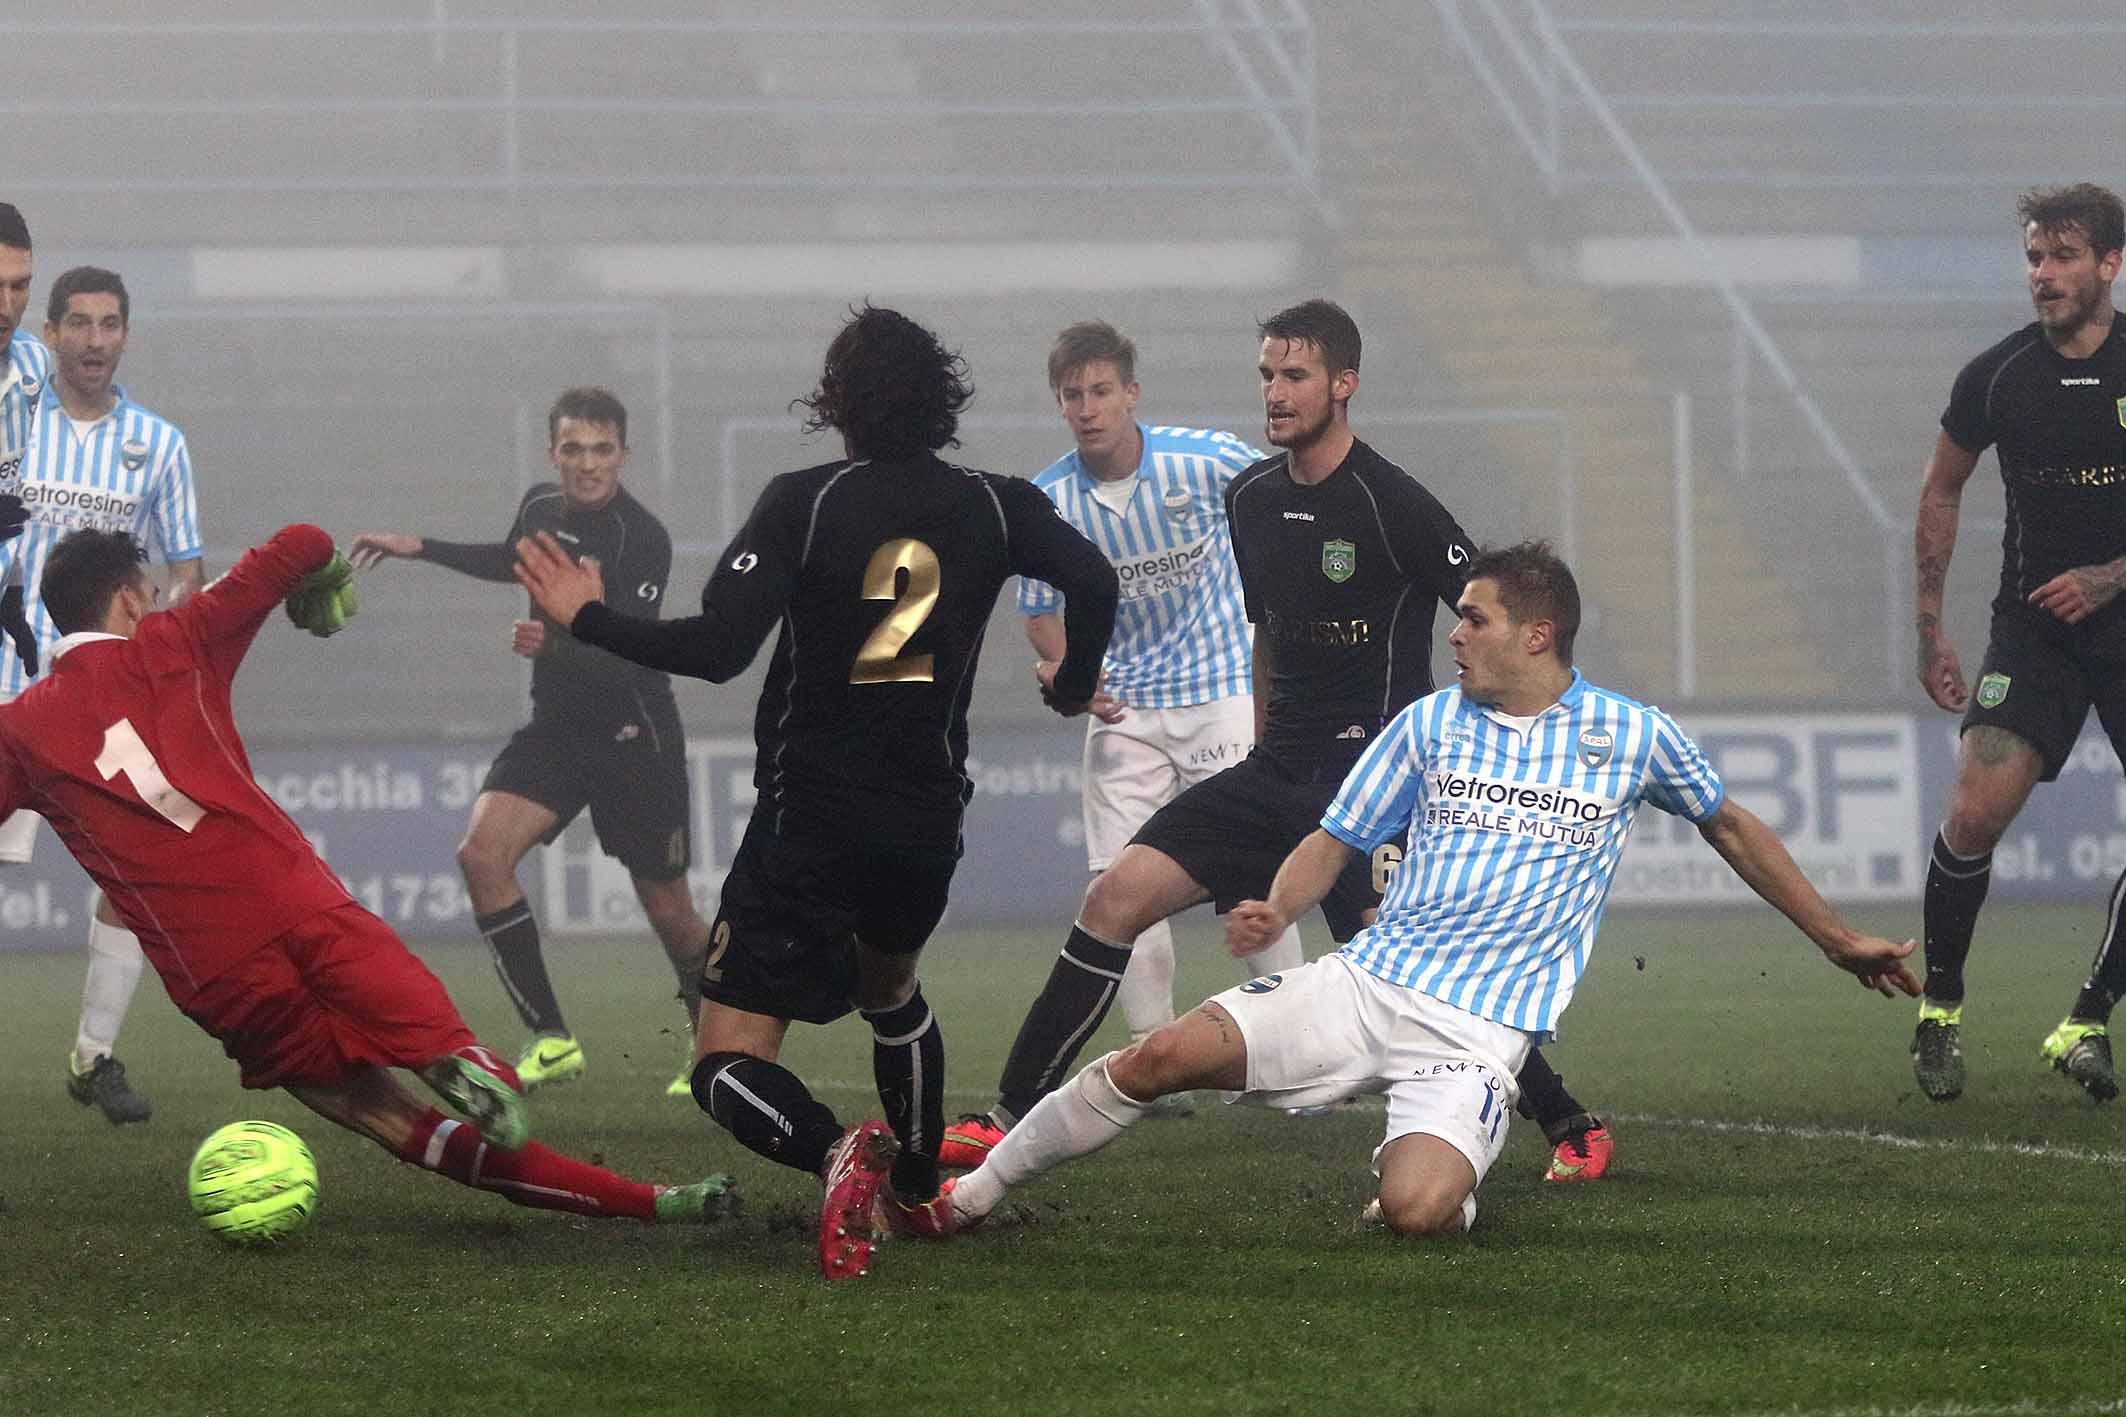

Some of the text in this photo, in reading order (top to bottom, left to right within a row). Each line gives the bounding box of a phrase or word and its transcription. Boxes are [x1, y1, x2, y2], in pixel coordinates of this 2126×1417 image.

[1113, 545, 1205, 581] oresina
[849, 537, 941, 684] 2
[94, 717, 208, 833] 1
[1437, 774, 1602, 822] Vetroresina
[1439, 809, 1596, 847] REALE MUTUA
[1372, 843, 1402, 894] 6
[703, 920, 731, 982] 2
